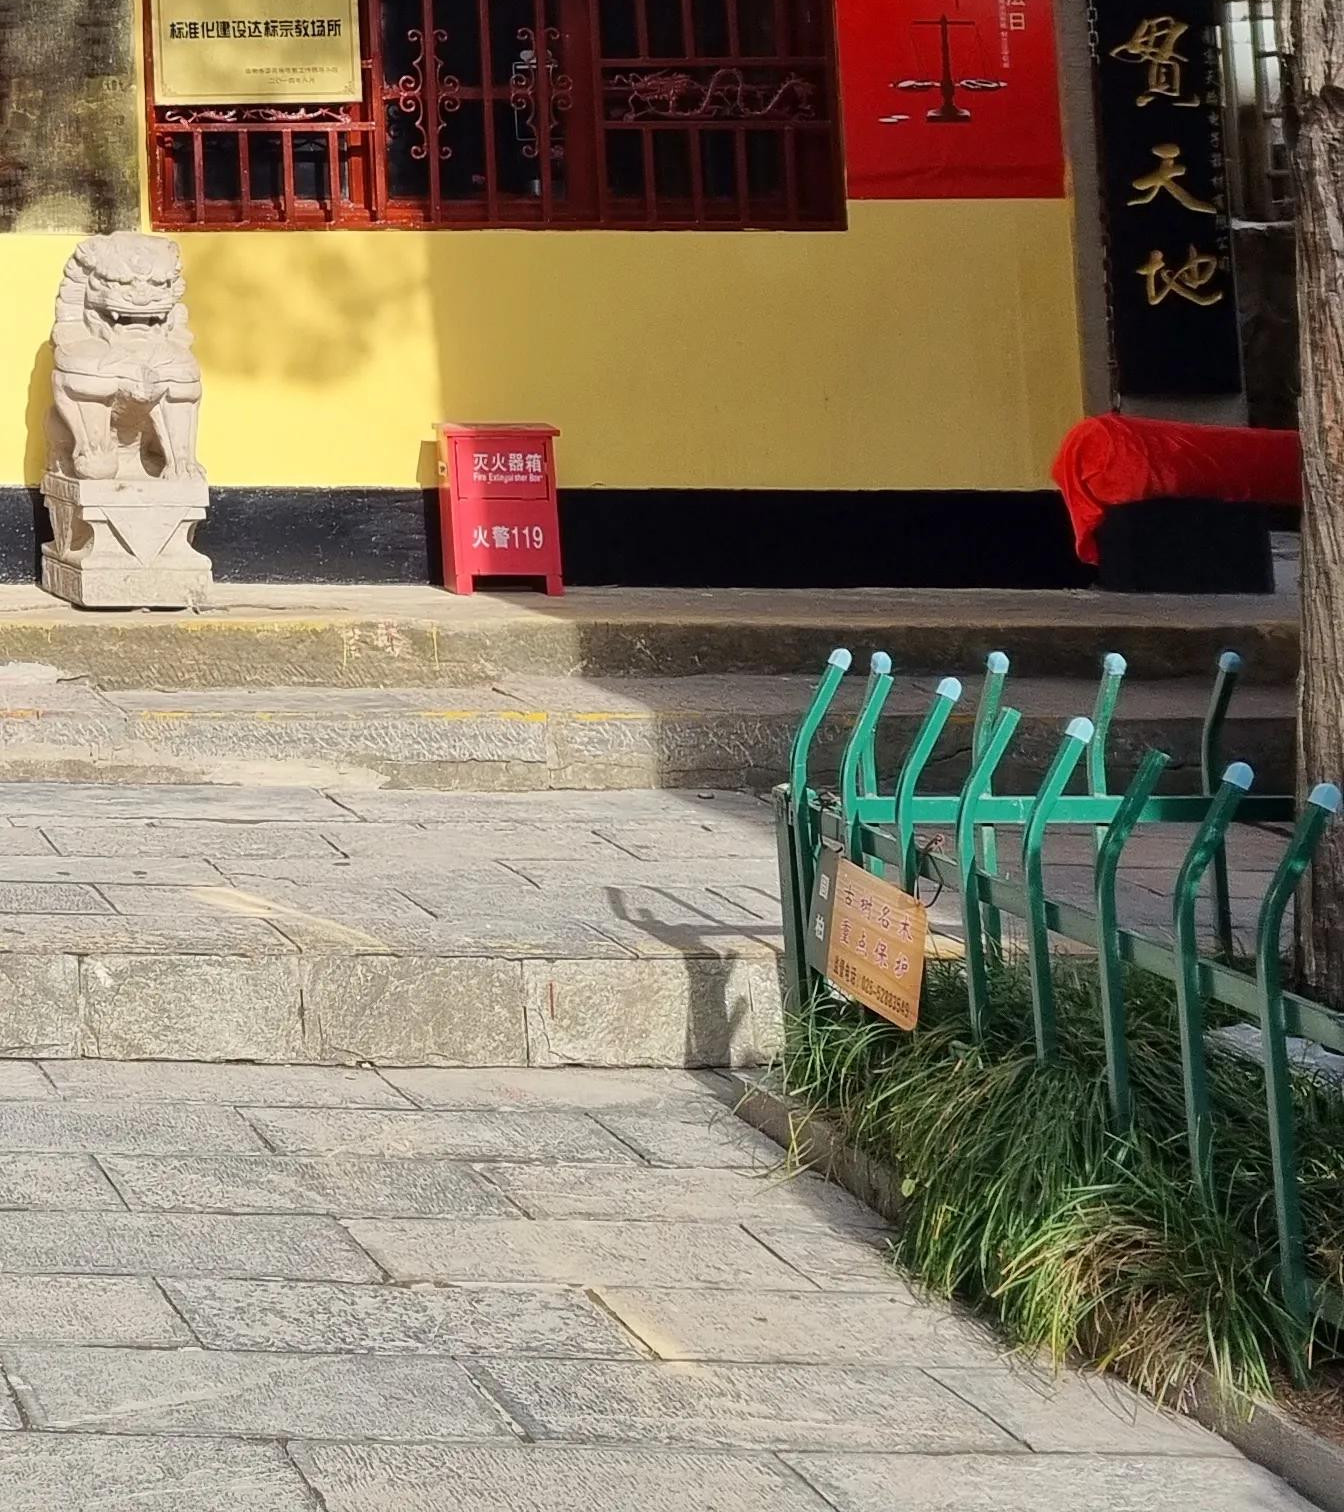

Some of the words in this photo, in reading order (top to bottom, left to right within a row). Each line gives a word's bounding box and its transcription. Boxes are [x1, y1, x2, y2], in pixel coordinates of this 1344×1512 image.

[169, 18, 342, 40] 标准化建设达标宗教场所
[473, 452, 543, 472] 灭火器箱
[472, 525, 544, 550] 火警119
[843, 883, 914, 943] 古树名木
[840, 918, 910, 979] 重点保护
